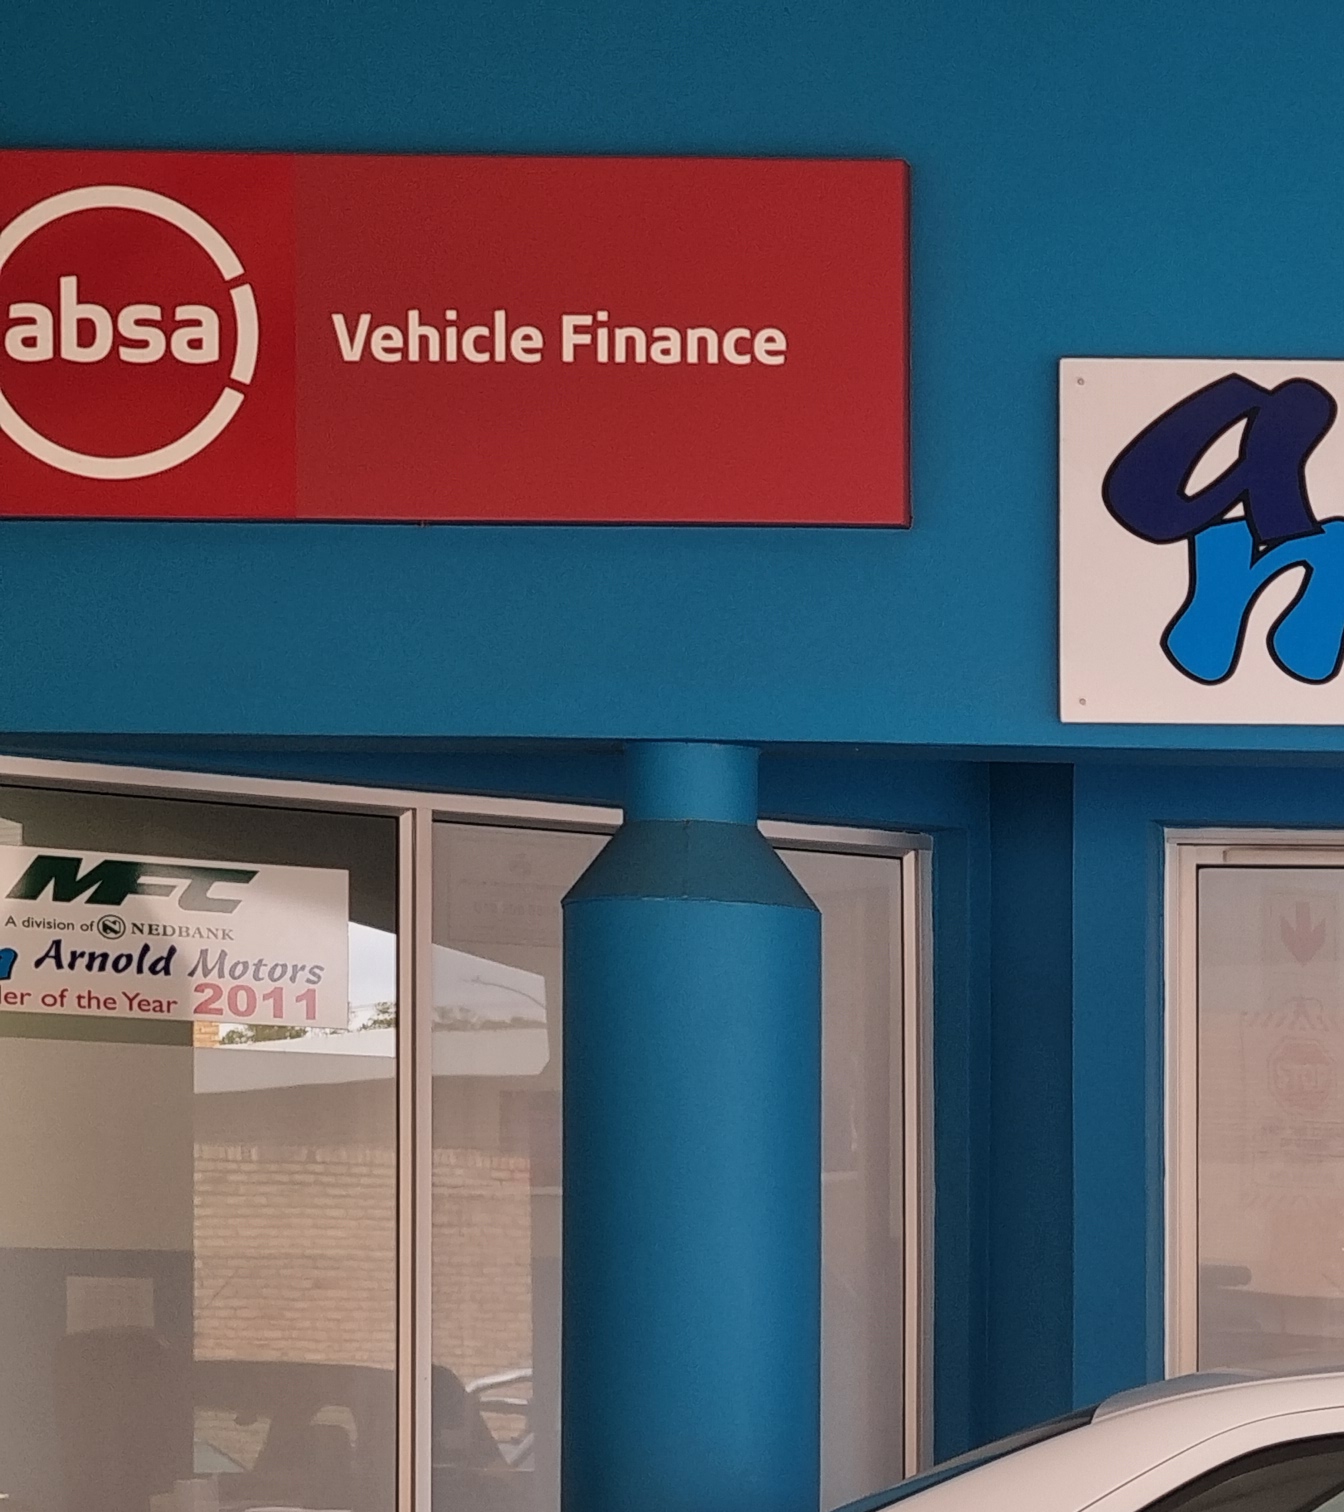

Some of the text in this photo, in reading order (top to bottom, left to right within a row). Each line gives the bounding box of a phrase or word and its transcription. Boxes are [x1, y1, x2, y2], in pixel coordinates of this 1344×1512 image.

[5, 276, 221, 364] absa
[332, 310, 786, 365] Vehicle Finance
[5, 855, 259, 914] MFC
[5, 916, 235, 941] A division of NEDBANK
[34, 939, 177, 977] Arnold
[187, 948, 325, 986] Motors
[42, 989, 68, 1007] of
[76, 990, 116, 1010] the
[122, 992, 177, 1013] Year
[193, 982, 318, 1020] 2011
